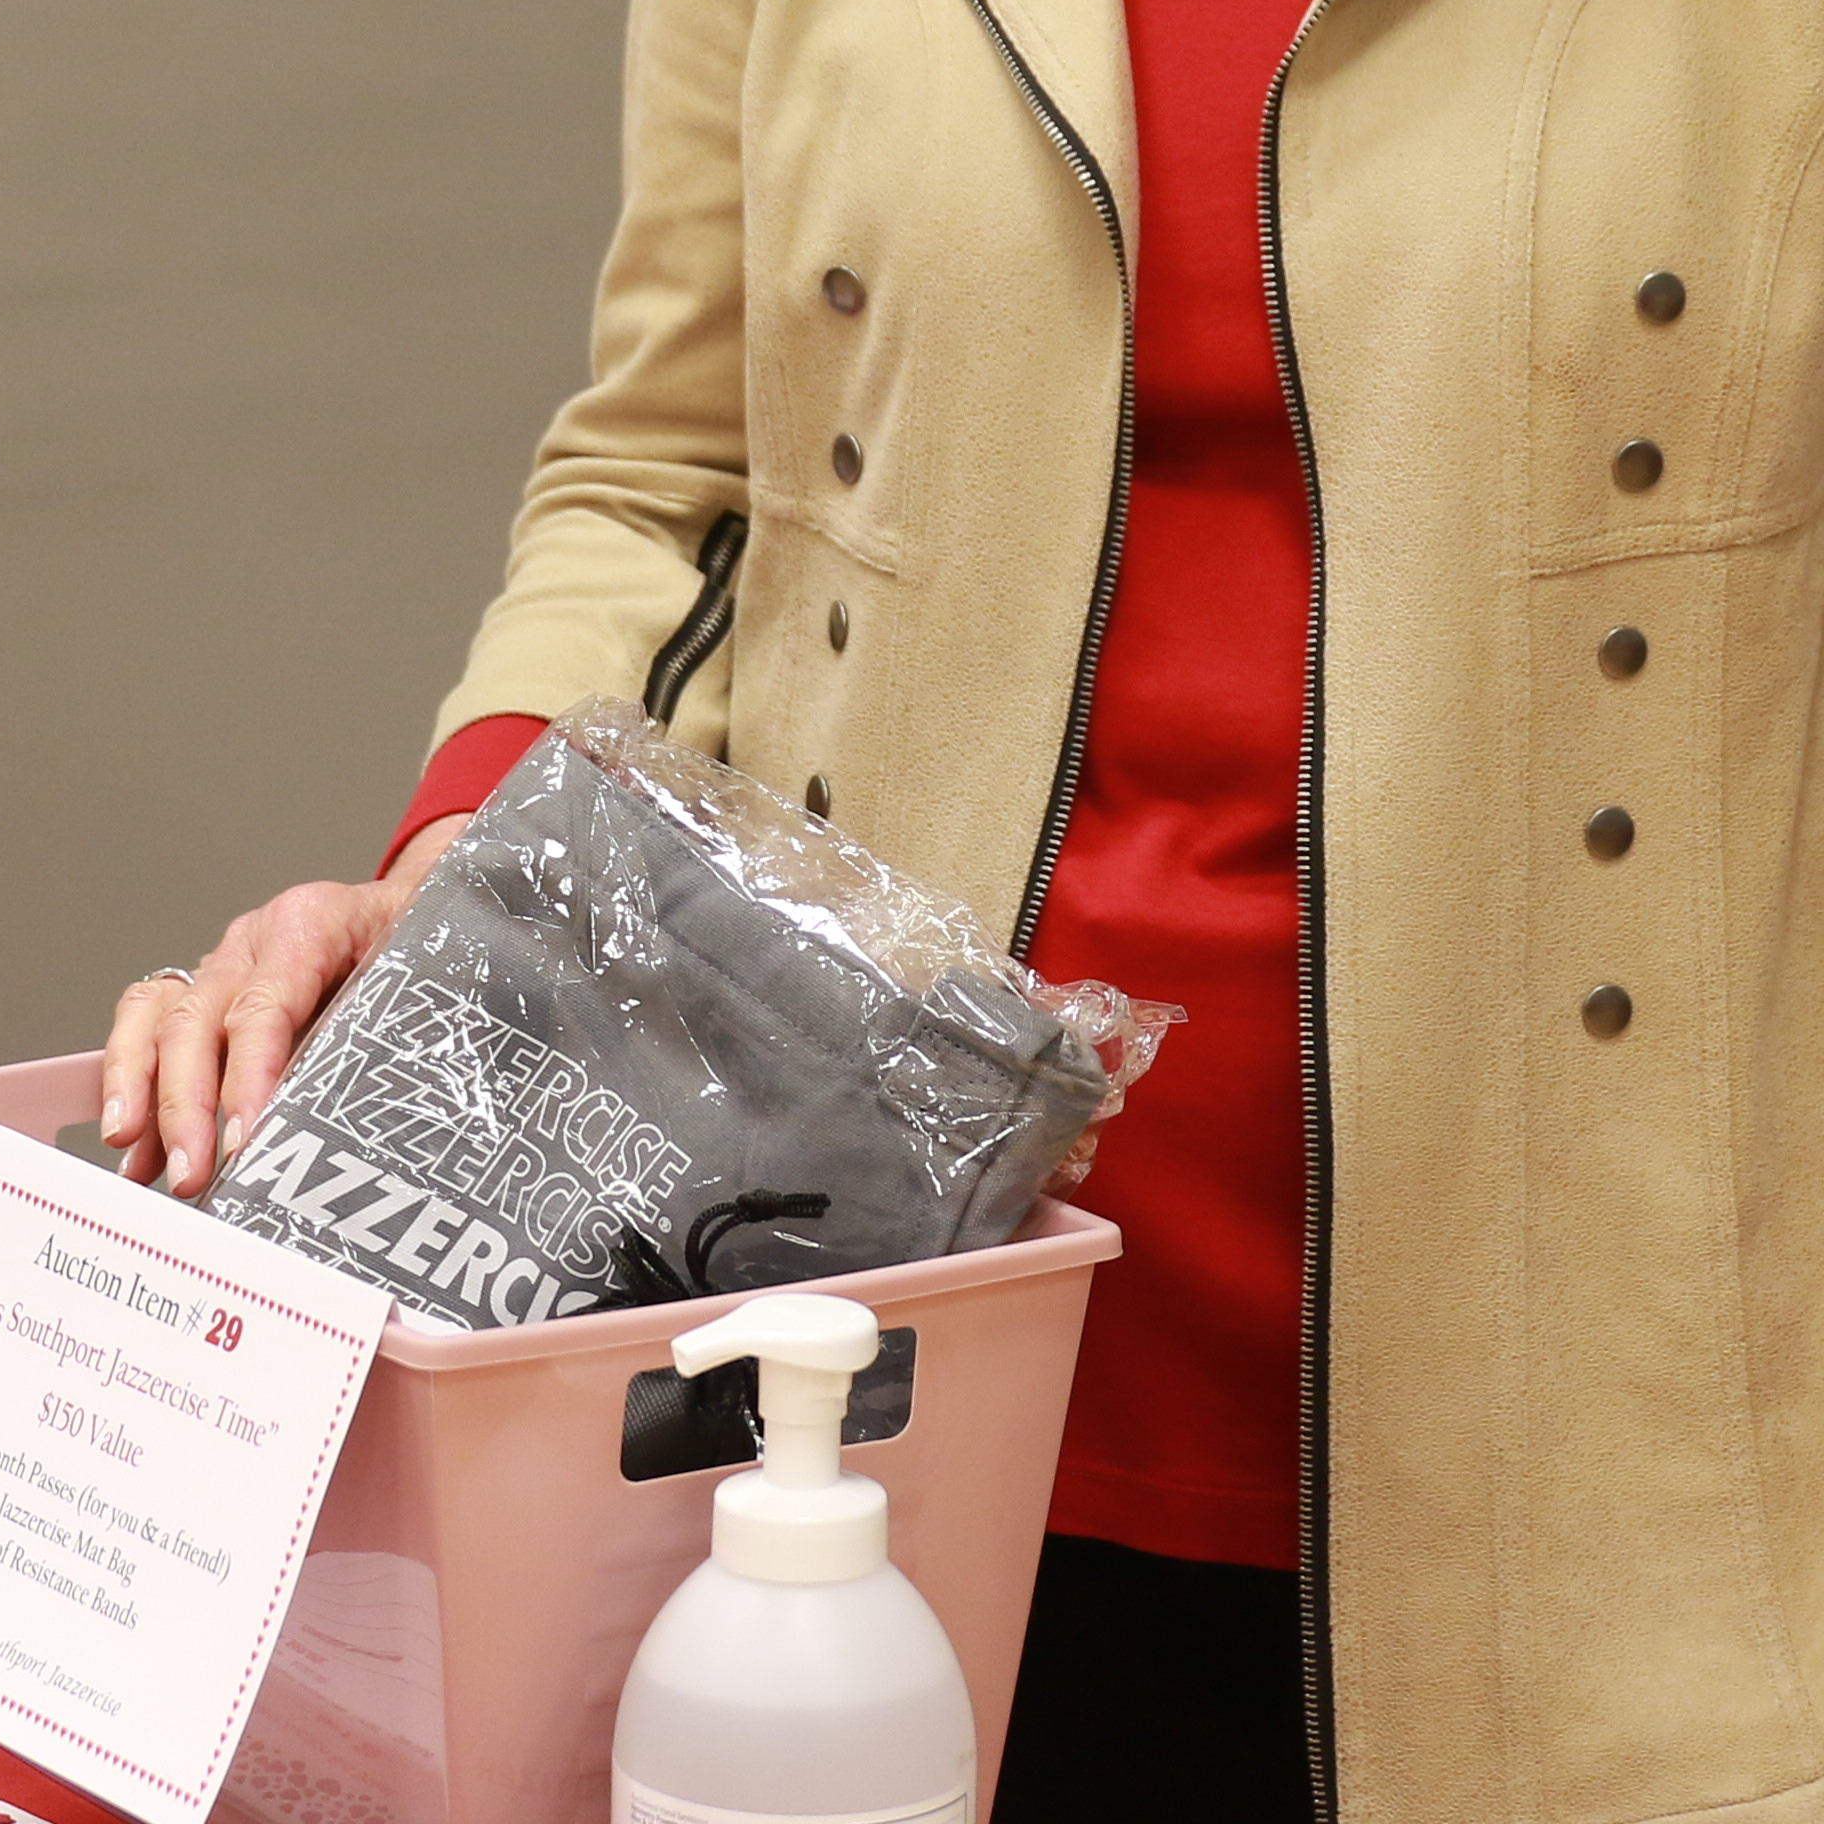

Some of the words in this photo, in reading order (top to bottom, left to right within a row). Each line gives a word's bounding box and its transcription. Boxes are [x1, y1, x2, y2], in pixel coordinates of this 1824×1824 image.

[334, 960, 692, 1223] AZZERCISE
[280, 1034, 660, 1288] AZZERCIS
[33, 1233, 123, 1302] Auction
[125, 1272, 180, 1327] Item
[181, 1297, 208, 1336] #
[204, 1307, 244, 1353] 29
[6, 1302, 107, 1372] Southport
[100, 1347, 210, 1421] Jazzercise
[214, 1395, 280, 1447] Time”
[37, 1391, 84, 1437] $150
[90, 1413, 144, 1468] Value
[27, 1460, 77, 1504] Passes
[76, 1483, 109, 1517] (for
[106, 1506, 140, 1535] you
[140, 1516, 160, 1544] &
[159, 1531, 170, 1551] a
[171, 1528, 232, 1587] friend!)
[72, 1529, 107, 1566] Mat
[106, 1546, 137, 1589] Bag
[9, 1545, 90, 1606] Resistance
[90, 1586, 139, 1630] Bands
[43, 1665, 122, 1717] Jazzercise
